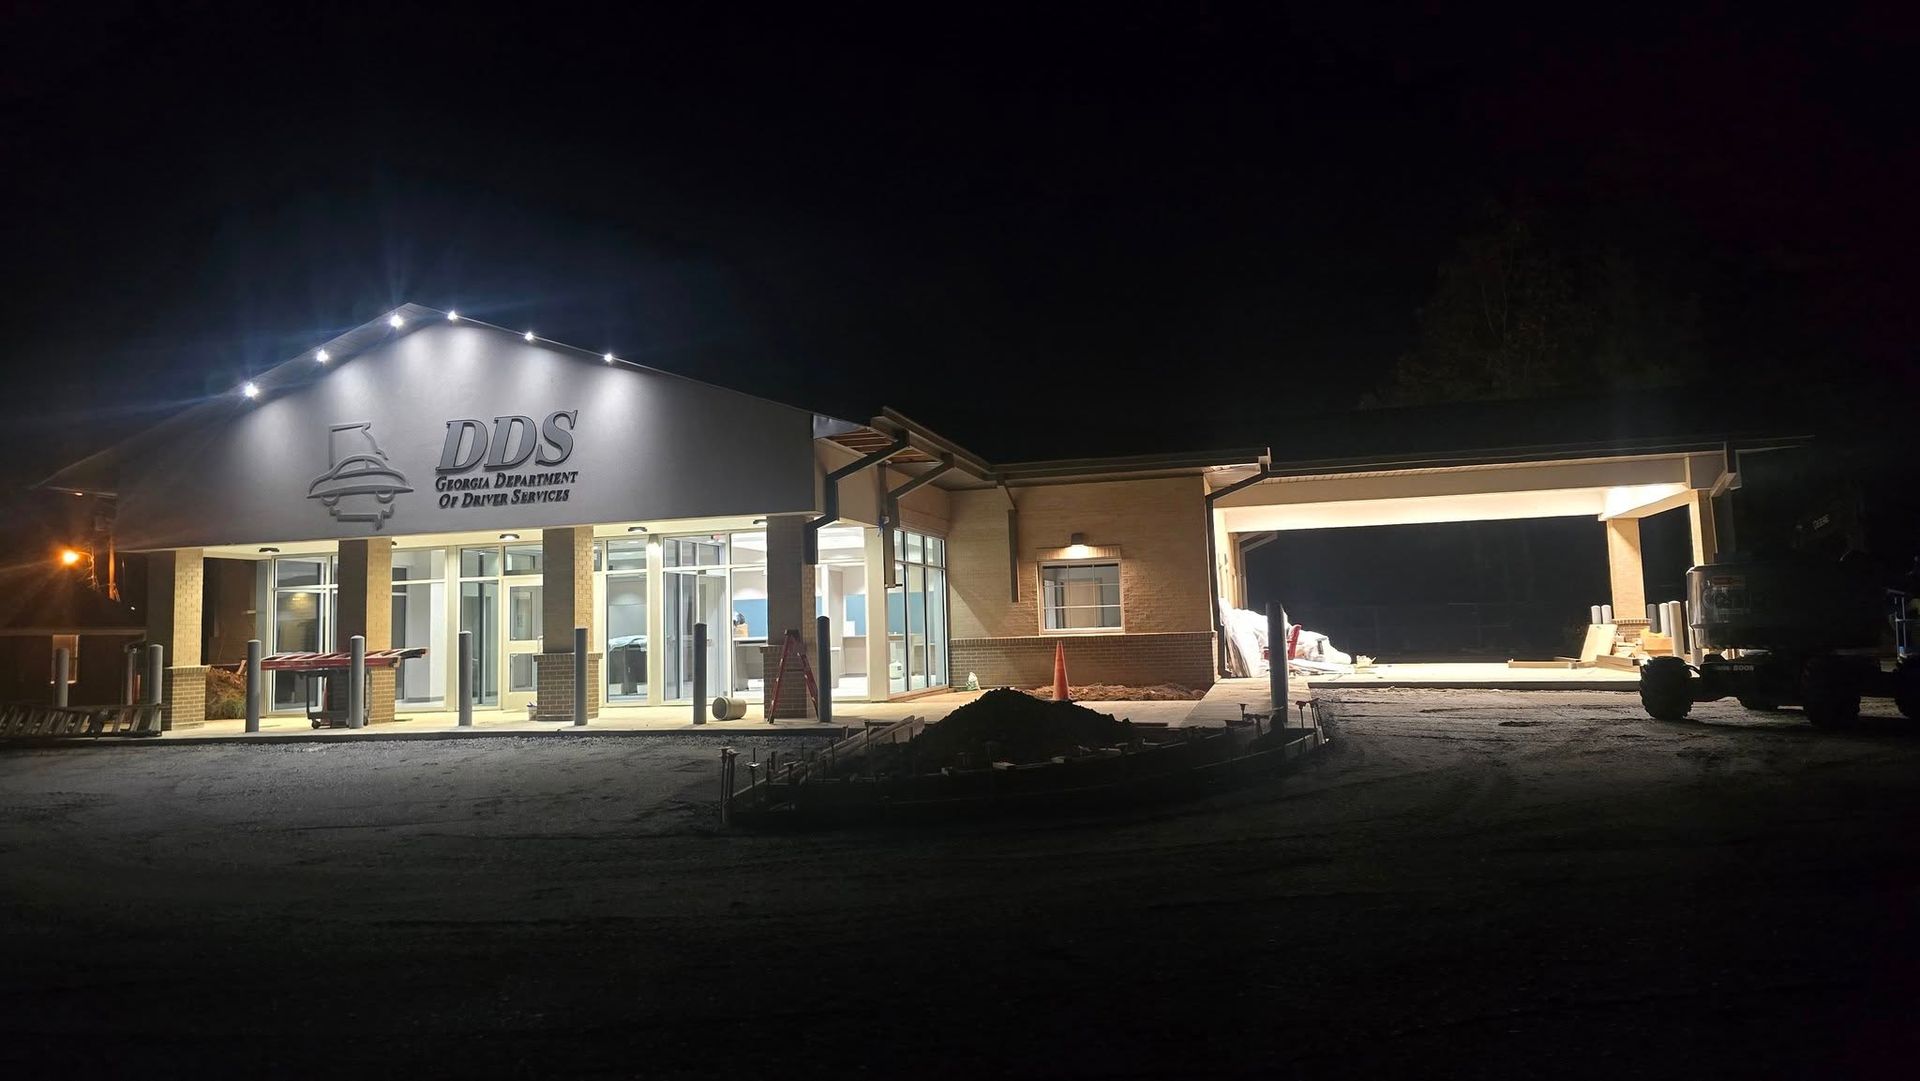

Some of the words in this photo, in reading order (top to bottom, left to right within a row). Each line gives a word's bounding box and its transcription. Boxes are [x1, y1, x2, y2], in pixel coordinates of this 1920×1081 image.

[435, 410, 578, 473] DDS
[435, 476, 490, 491] GEORGIA
[494, 471, 578, 488] DEPARTMENT
[462, 492, 508, 507] DRIVER
[511, 489, 570, 504] SERVICES
